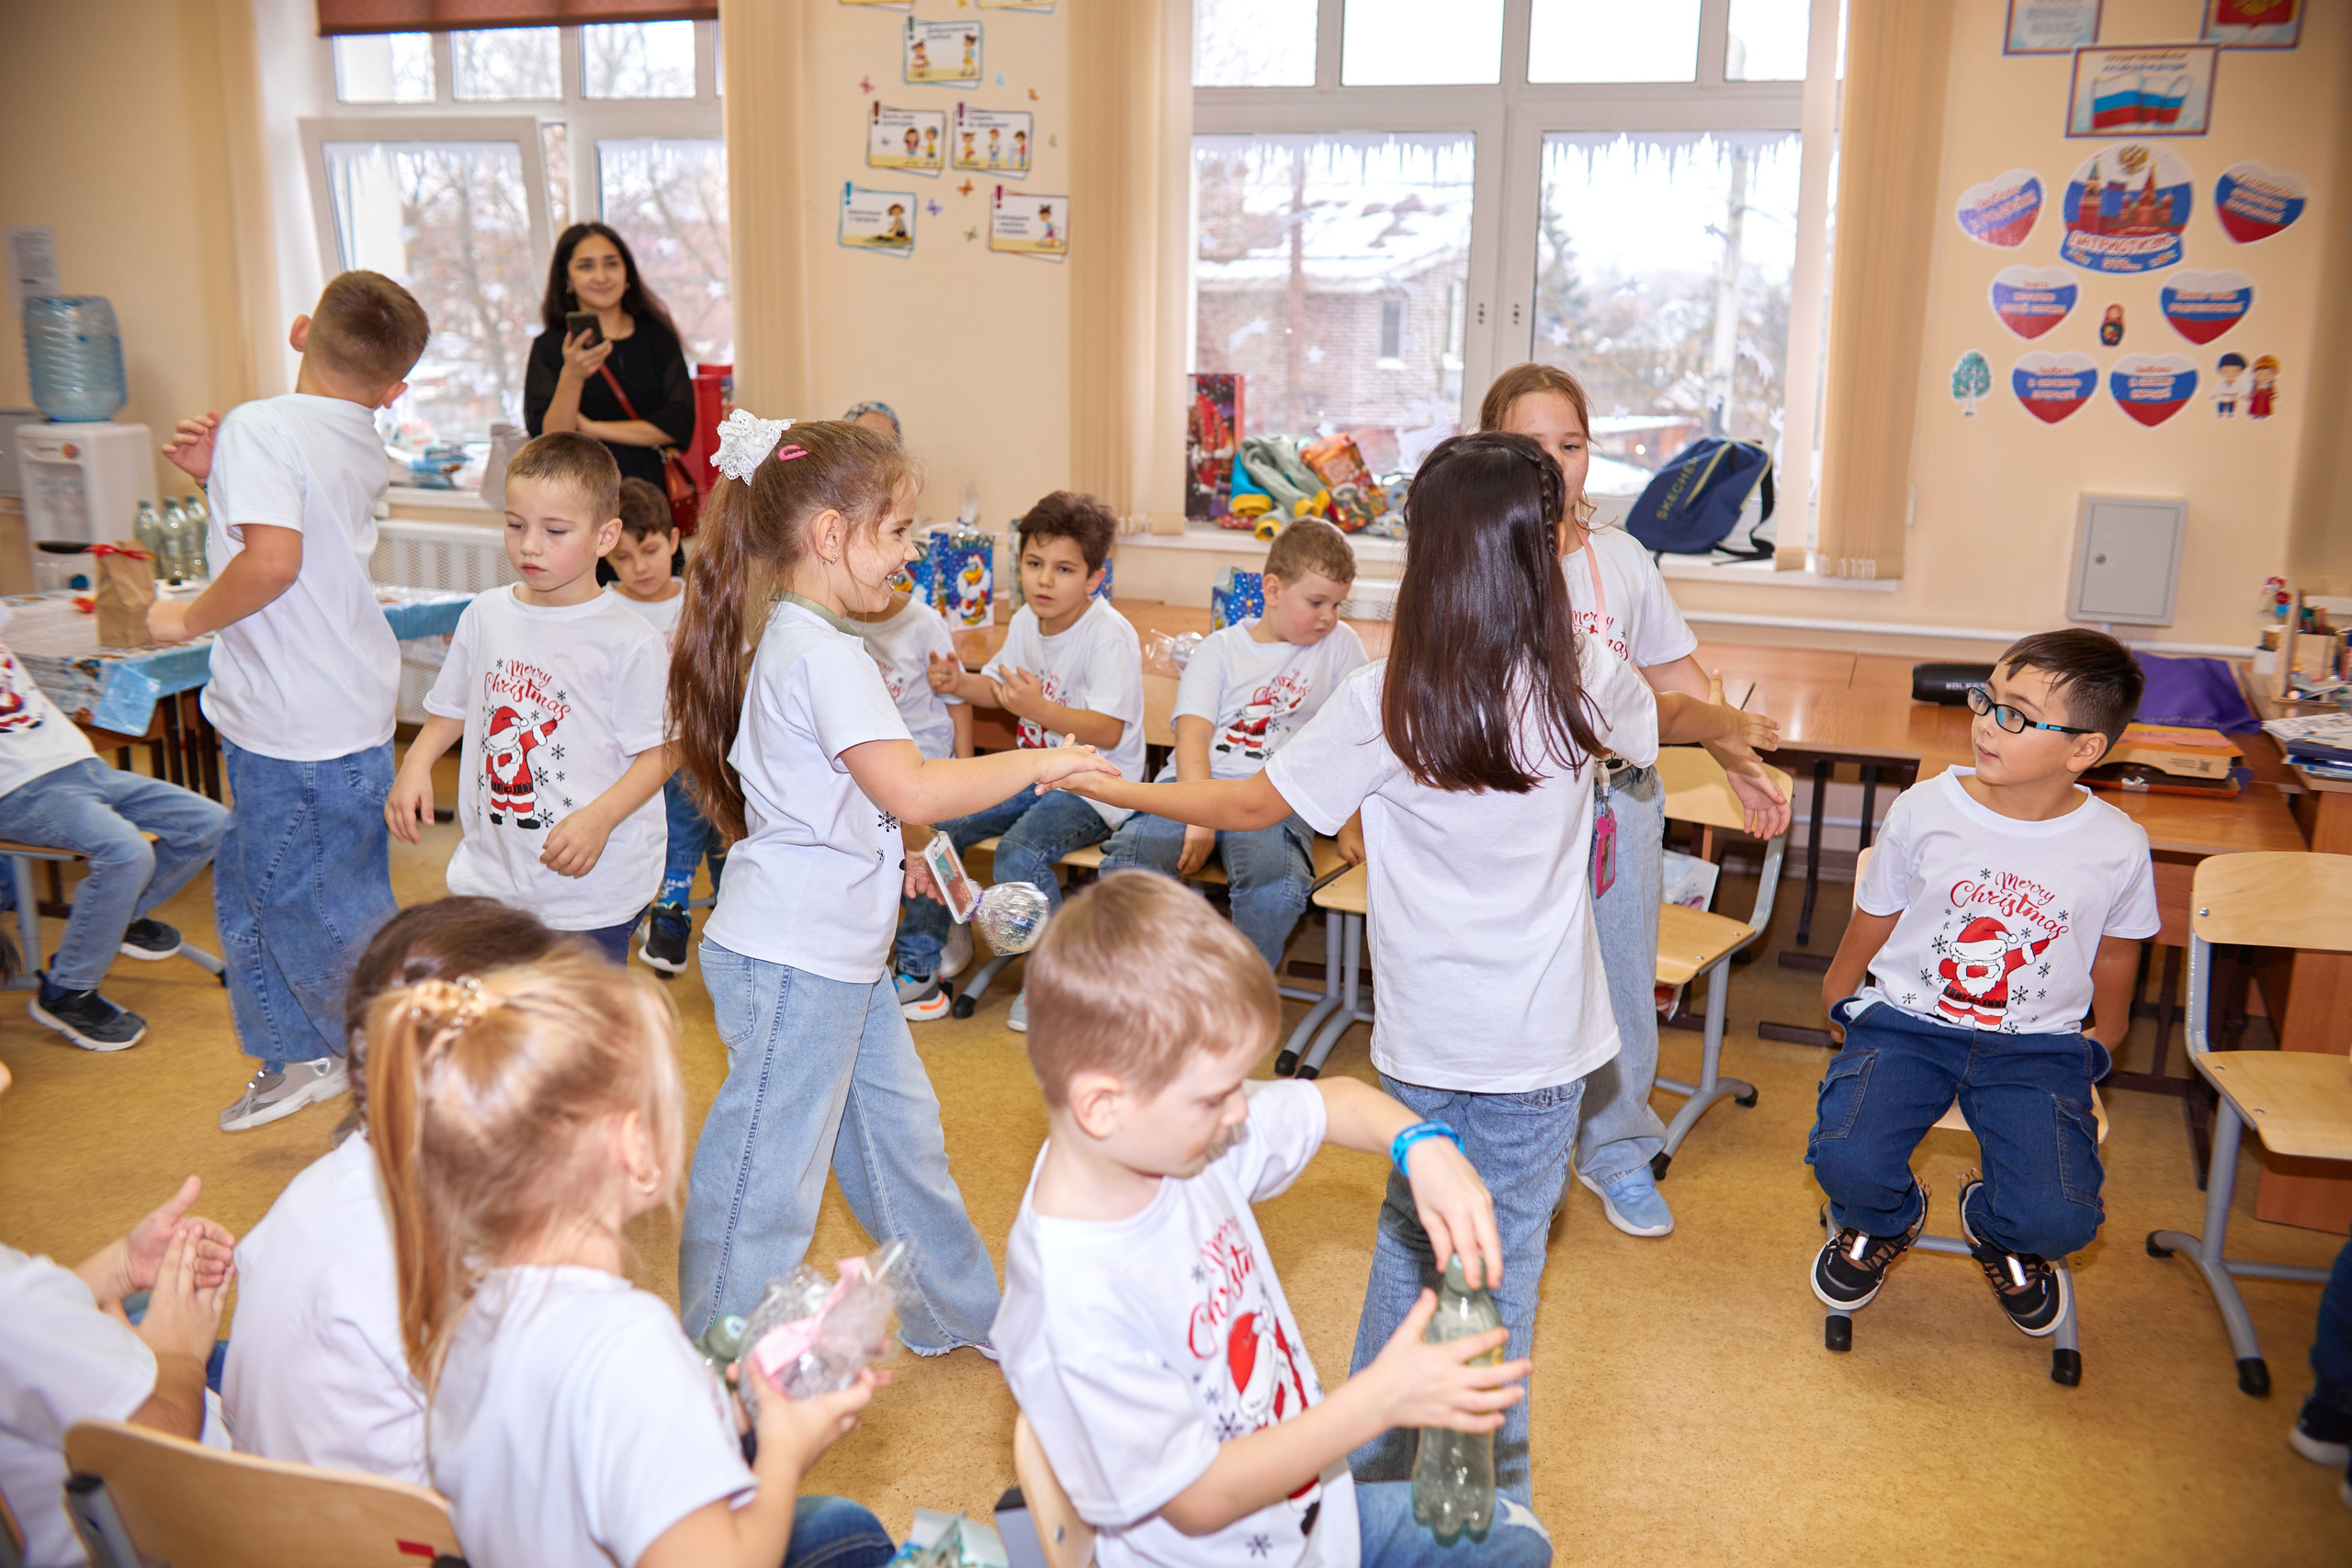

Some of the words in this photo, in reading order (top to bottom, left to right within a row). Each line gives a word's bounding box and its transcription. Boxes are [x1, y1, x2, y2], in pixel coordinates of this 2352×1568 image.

[1573, 610, 1614, 630] Mery
[506, 660, 552, 687] Merry
[484, 671, 571, 722] Christmas
[1995, 872, 2055, 906] Merry
[1951, 879, 2069, 941] Christmas
